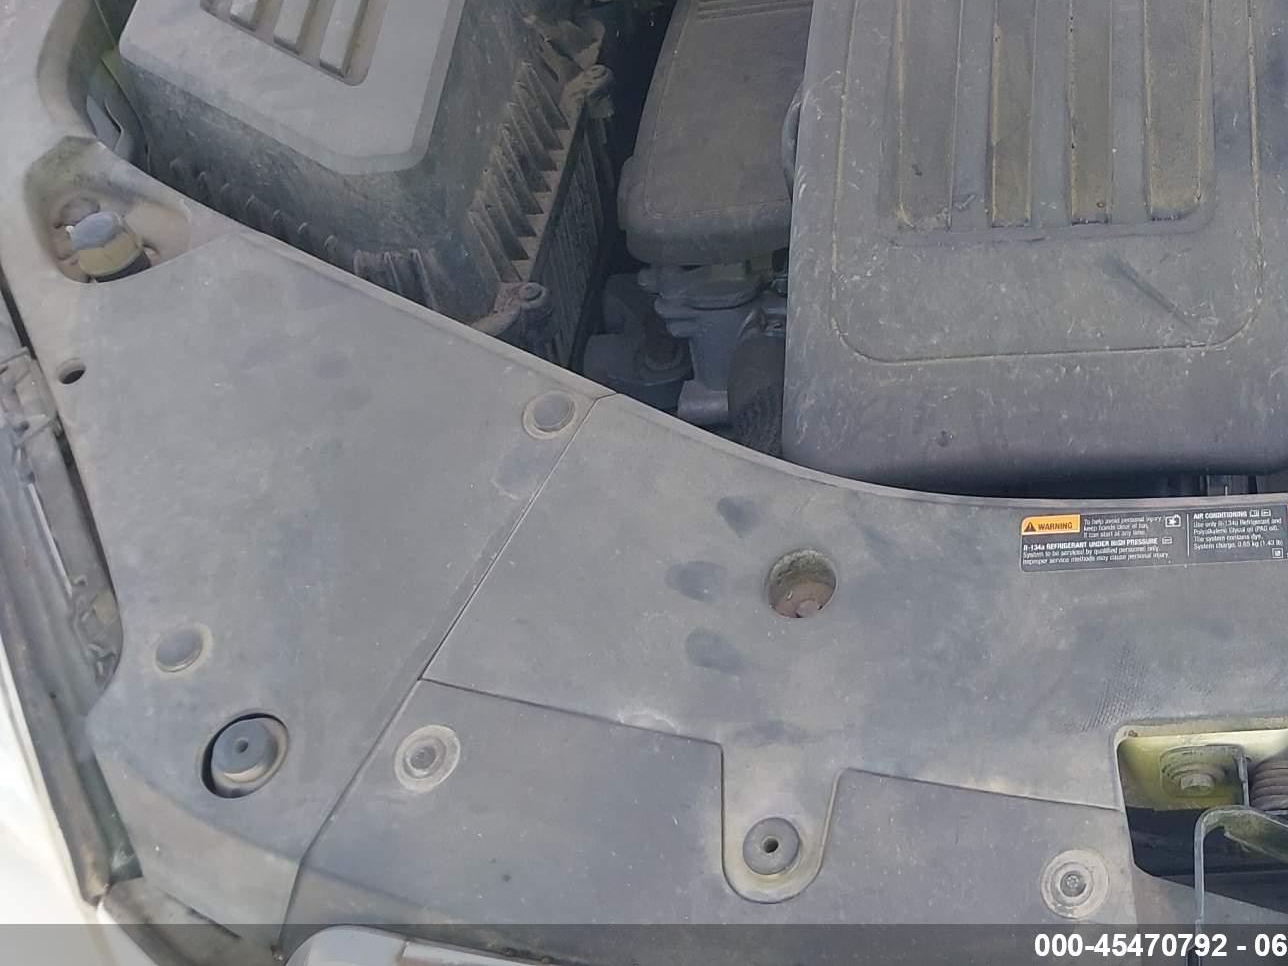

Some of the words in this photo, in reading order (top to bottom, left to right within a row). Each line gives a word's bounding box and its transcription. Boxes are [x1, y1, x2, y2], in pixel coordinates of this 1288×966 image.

[1205, 511, 1247, 519] CONDITIONING
[1121, 516, 1144, 525] personal
[1038, 522, 1072, 531] WARNING
